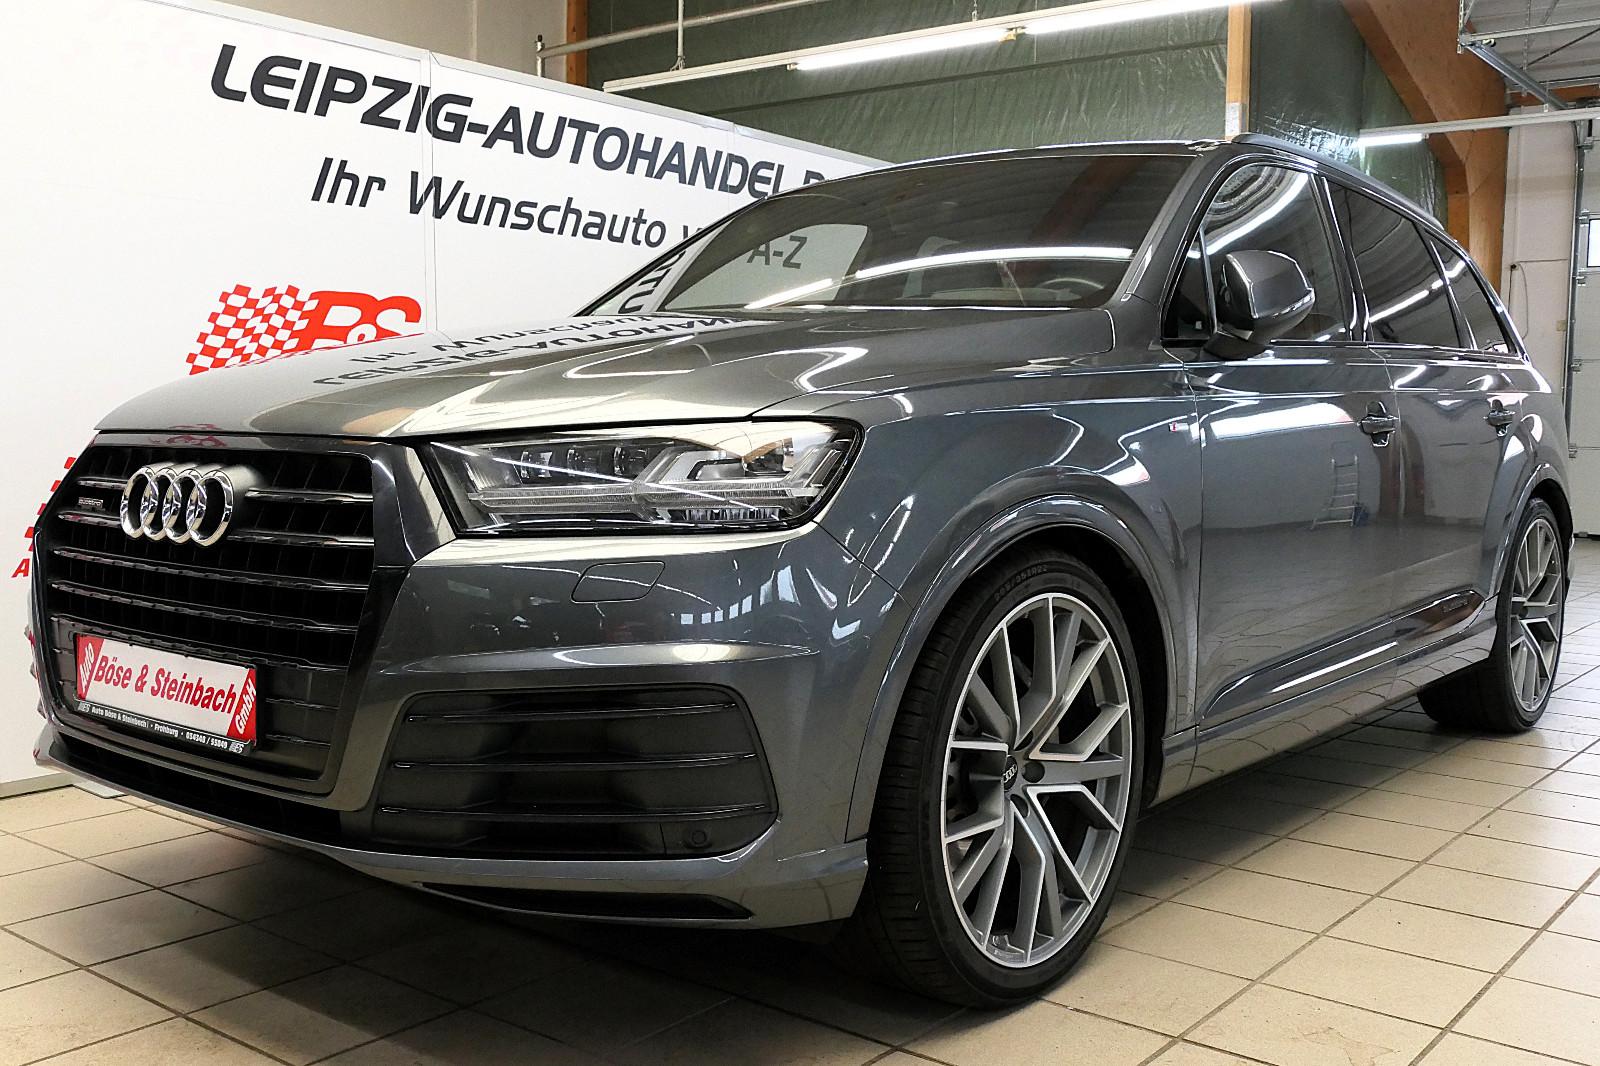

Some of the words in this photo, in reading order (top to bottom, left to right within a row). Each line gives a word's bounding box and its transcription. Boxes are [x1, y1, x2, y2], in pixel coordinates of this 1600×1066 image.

[311, 156, 386, 207] Ihr
[409, 170, 667, 248] Wunschauto
[79, 642, 95, 694] Auto
[94, 655, 132, 689] Böse
[134, 664, 149, 693] &
[150, 668, 238, 714] Steinbach
[235, 677, 256, 735] GmbH
